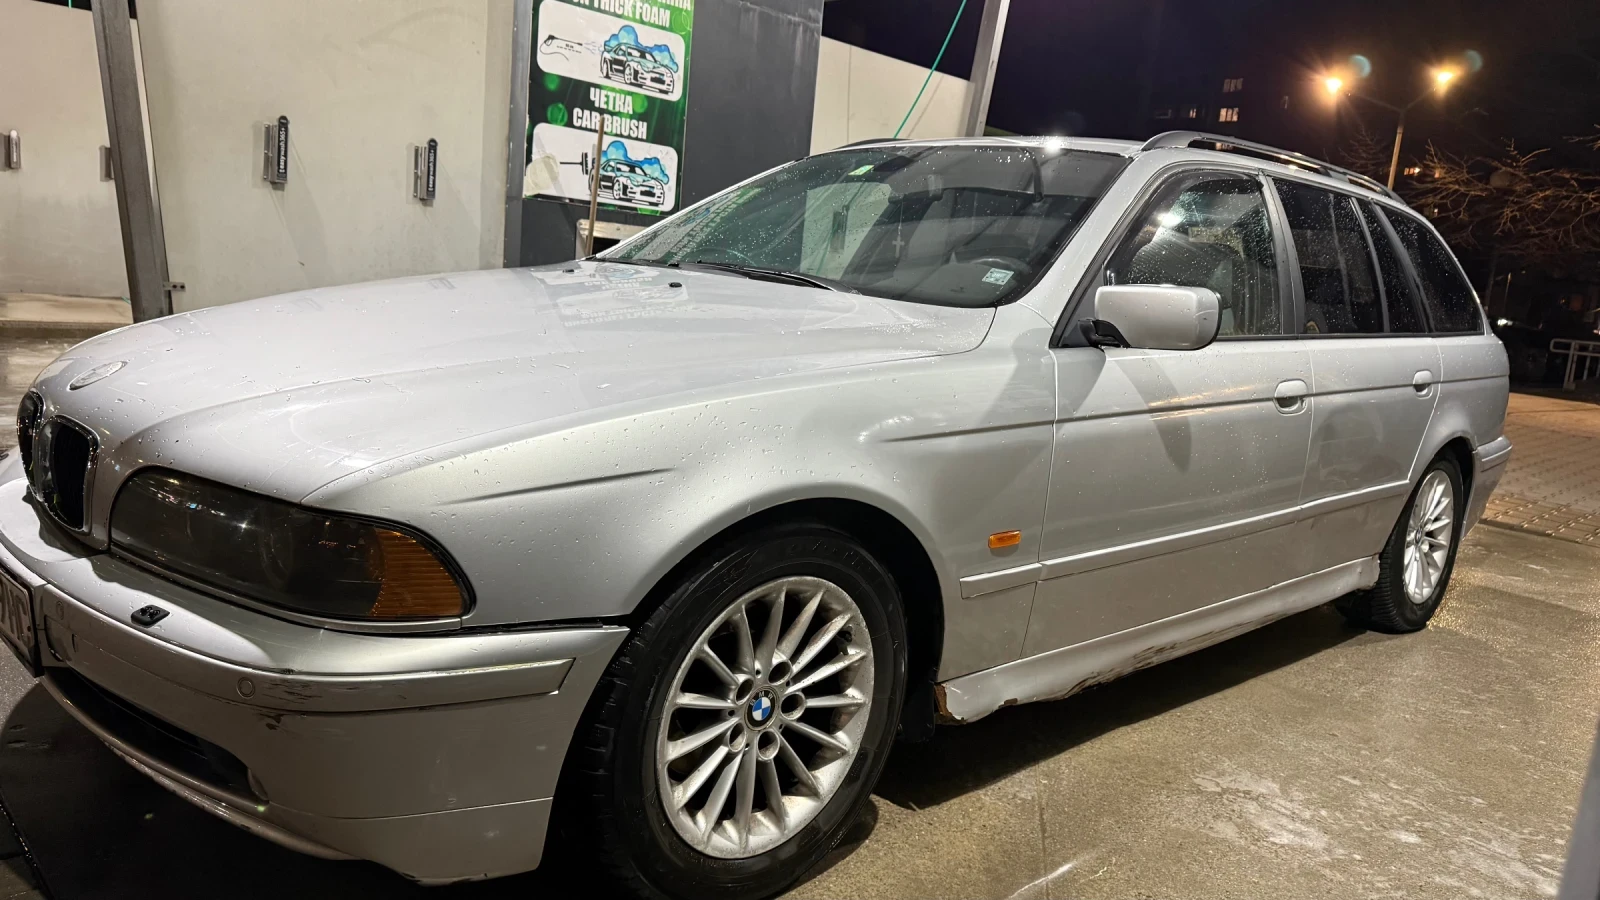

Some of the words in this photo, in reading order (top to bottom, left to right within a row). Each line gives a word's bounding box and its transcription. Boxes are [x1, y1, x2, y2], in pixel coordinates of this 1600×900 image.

[635, 2, 670, 28] FOAM
[590, 87, 633, 114] ЧЕТКА
[573, 107, 601, 132] CAR
[603, 113, 647, 139] BRUSH
[750, 690, 773, 706] BMW
